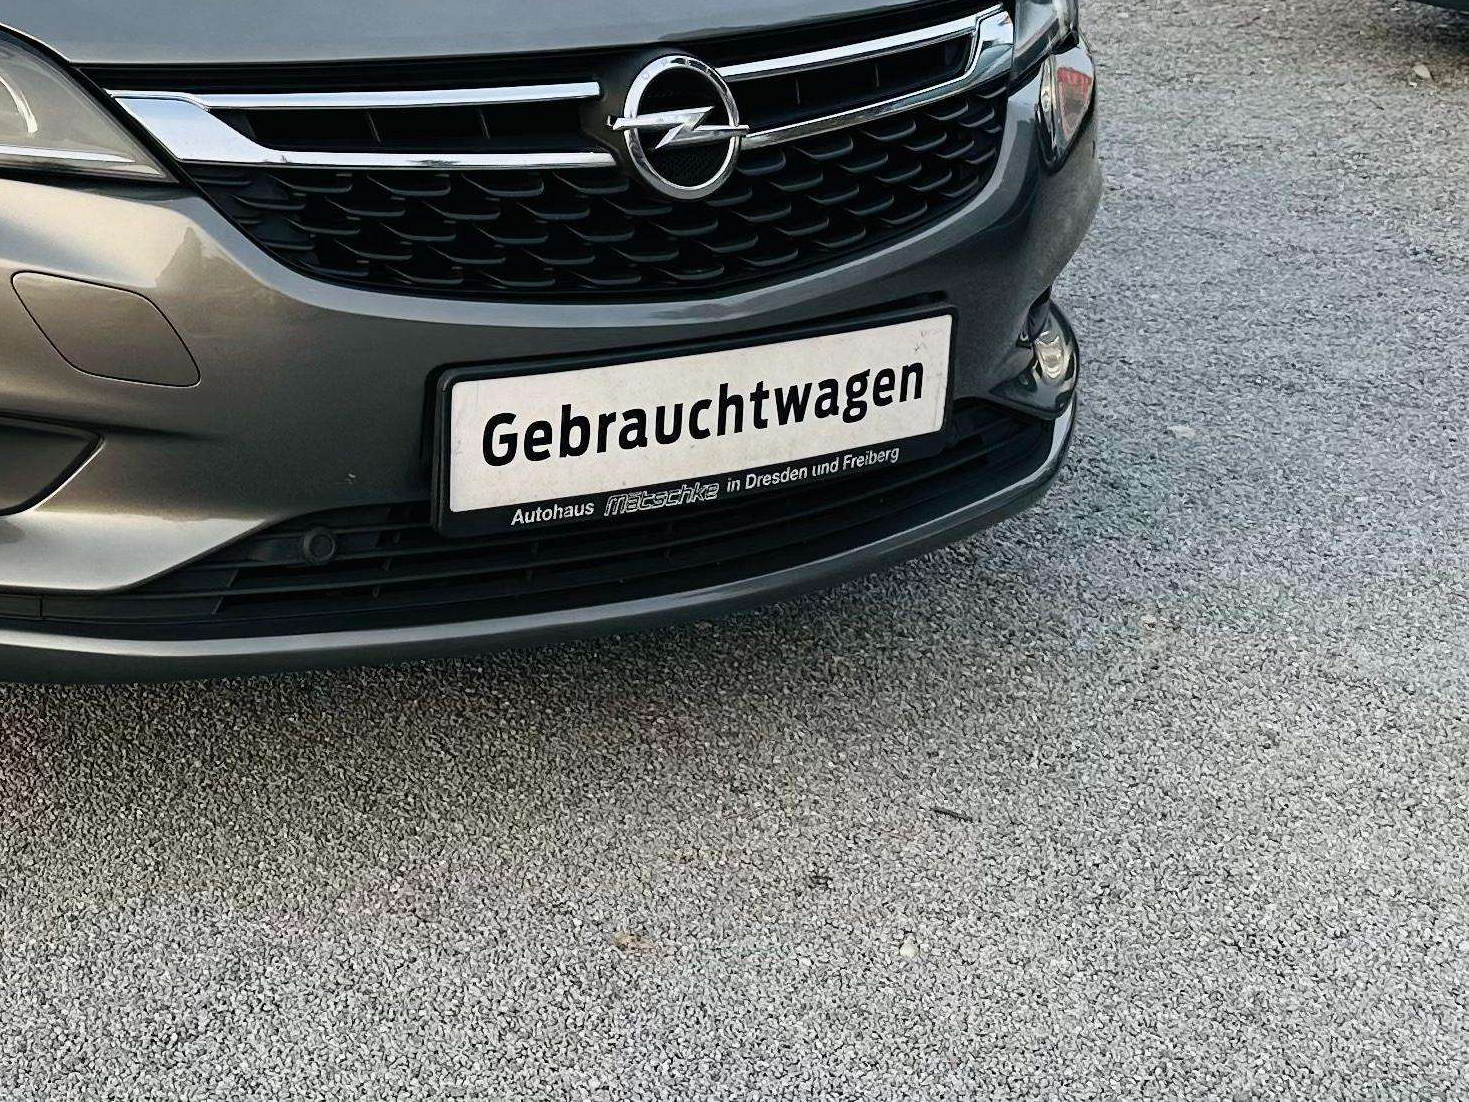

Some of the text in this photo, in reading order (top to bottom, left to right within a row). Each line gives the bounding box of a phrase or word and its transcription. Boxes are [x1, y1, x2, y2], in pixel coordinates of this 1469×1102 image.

[482, 361, 924, 467] Gebrauchtwagen
[511, 500, 595, 526] Autohaus
[727, 477, 741, 493] in
[746, 466, 808, 490] Dresden
[812, 462, 839, 477] und
[843, 445, 900, 470] Freiberg
